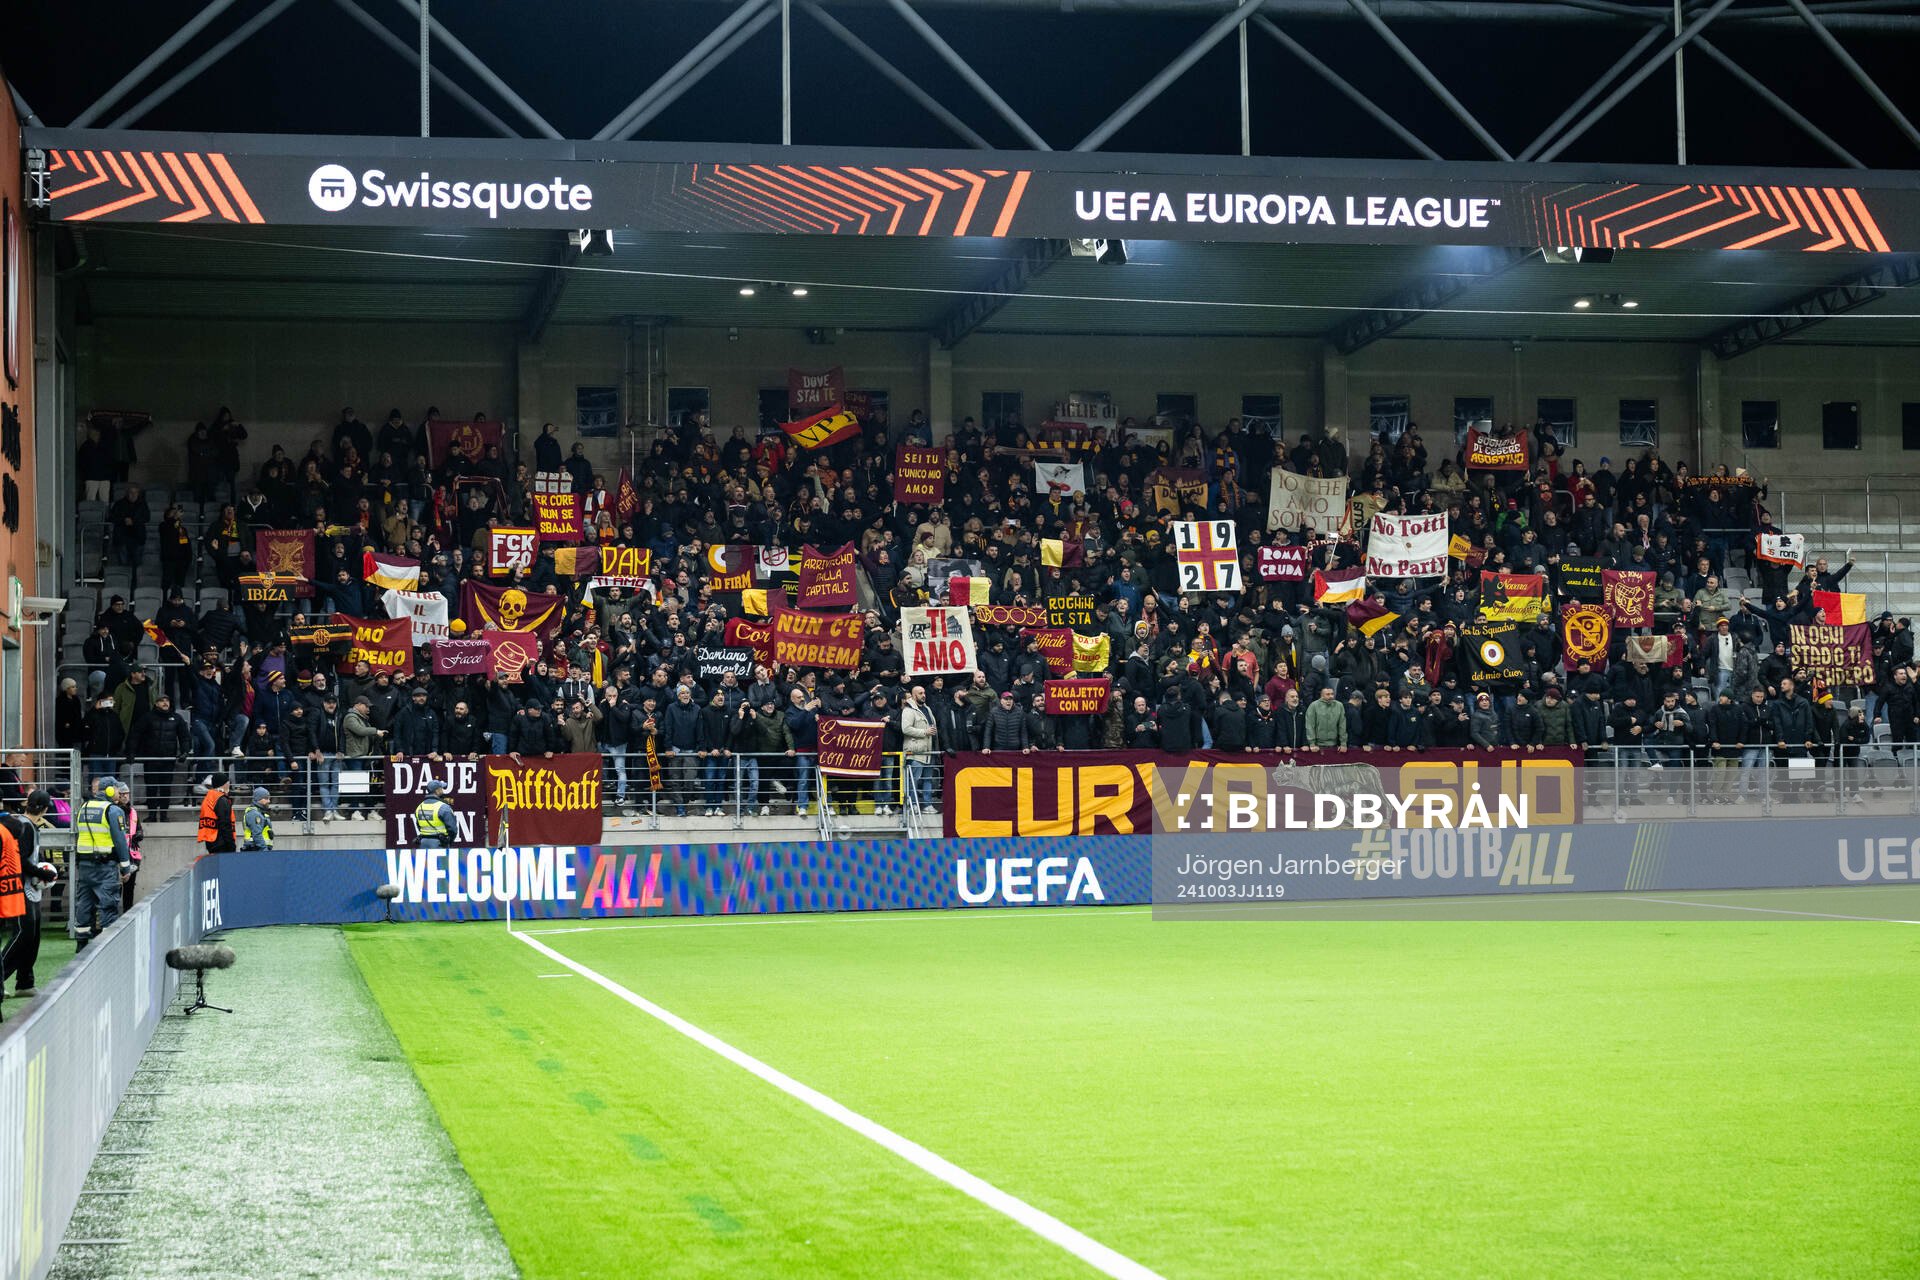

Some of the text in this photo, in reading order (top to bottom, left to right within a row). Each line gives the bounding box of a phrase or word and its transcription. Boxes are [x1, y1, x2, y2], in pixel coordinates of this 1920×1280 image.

[361, 169, 593, 218] Swissquote
[1075, 190, 1177, 222] UEFA
[1186, 192, 1336, 226] EUROPA
[905, 453, 939, 464] SEI TU
[899, 468, 942, 480] L'UNICO MIO
[905, 484, 934, 495] AMOR
[1279, 473, 1342, 496] IO CHE
[535, 494, 575, 506] ER CORE
[1287, 495, 1329, 513] AMO
[540, 508, 574, 520] NUN SE
[1180, 522, 1231, 549] 1 9
[1371, 516, 1395, 537] No
[1398, 514, 1446, 537] Totti
[492, 534, 535, 552] FCK
[1262, 548, 1303, 561] ROMA
[1260, 564, 1303, 576] CRUDA
[1368, 556, 1393, 576] No
[1399, 555, 1448, 577] Party
[595, 577, 648, 588] TI AMO
[724, 571, 752, 590] FIRM
[1184, 564, 1234, 590] 2 7
[247, 588, 288, 601] IBIZA
[805, 582, 849, 597] CAPITALE
[413, 604, 427, 616] IL
[1051, 612, 1065, 626] CE
[776, 613, 824, 636] NUN
[926, 609, 947, 638] TI
[1472, 625, 1480, 636] la
[1482, 622, 1516, 639] Squadra
[1790, 624, 1844, 645] IN OGNI
[698, 647, 748, 662] Damiano
[776, 641, 860, 666] PROBLEMA
[912, 640, 967, 672] AMO
[1791, 645, 1844, 666] STADIO
[1486, 670, 1502, 680] mio
[1051, 687, 1105, 699] ZAGAJETTO
[1059, 700, 1098, 712] CON NOI
[820, 719, 879, 749] Emilio
[819, 750, 874, 768] con noi
[392, 762, 477, 794] DAJE
[489, 765, 600, 812] Diffidati
[955, 759, 1575, 839] CURVA SUD
[395, 811, 476, 845] IVN
[1351, 826, 1576, 887] #FOOTBALL
[386, 846, 664, 909] WELCOME ALL
[957, 856, 1104, 903] UEFA
